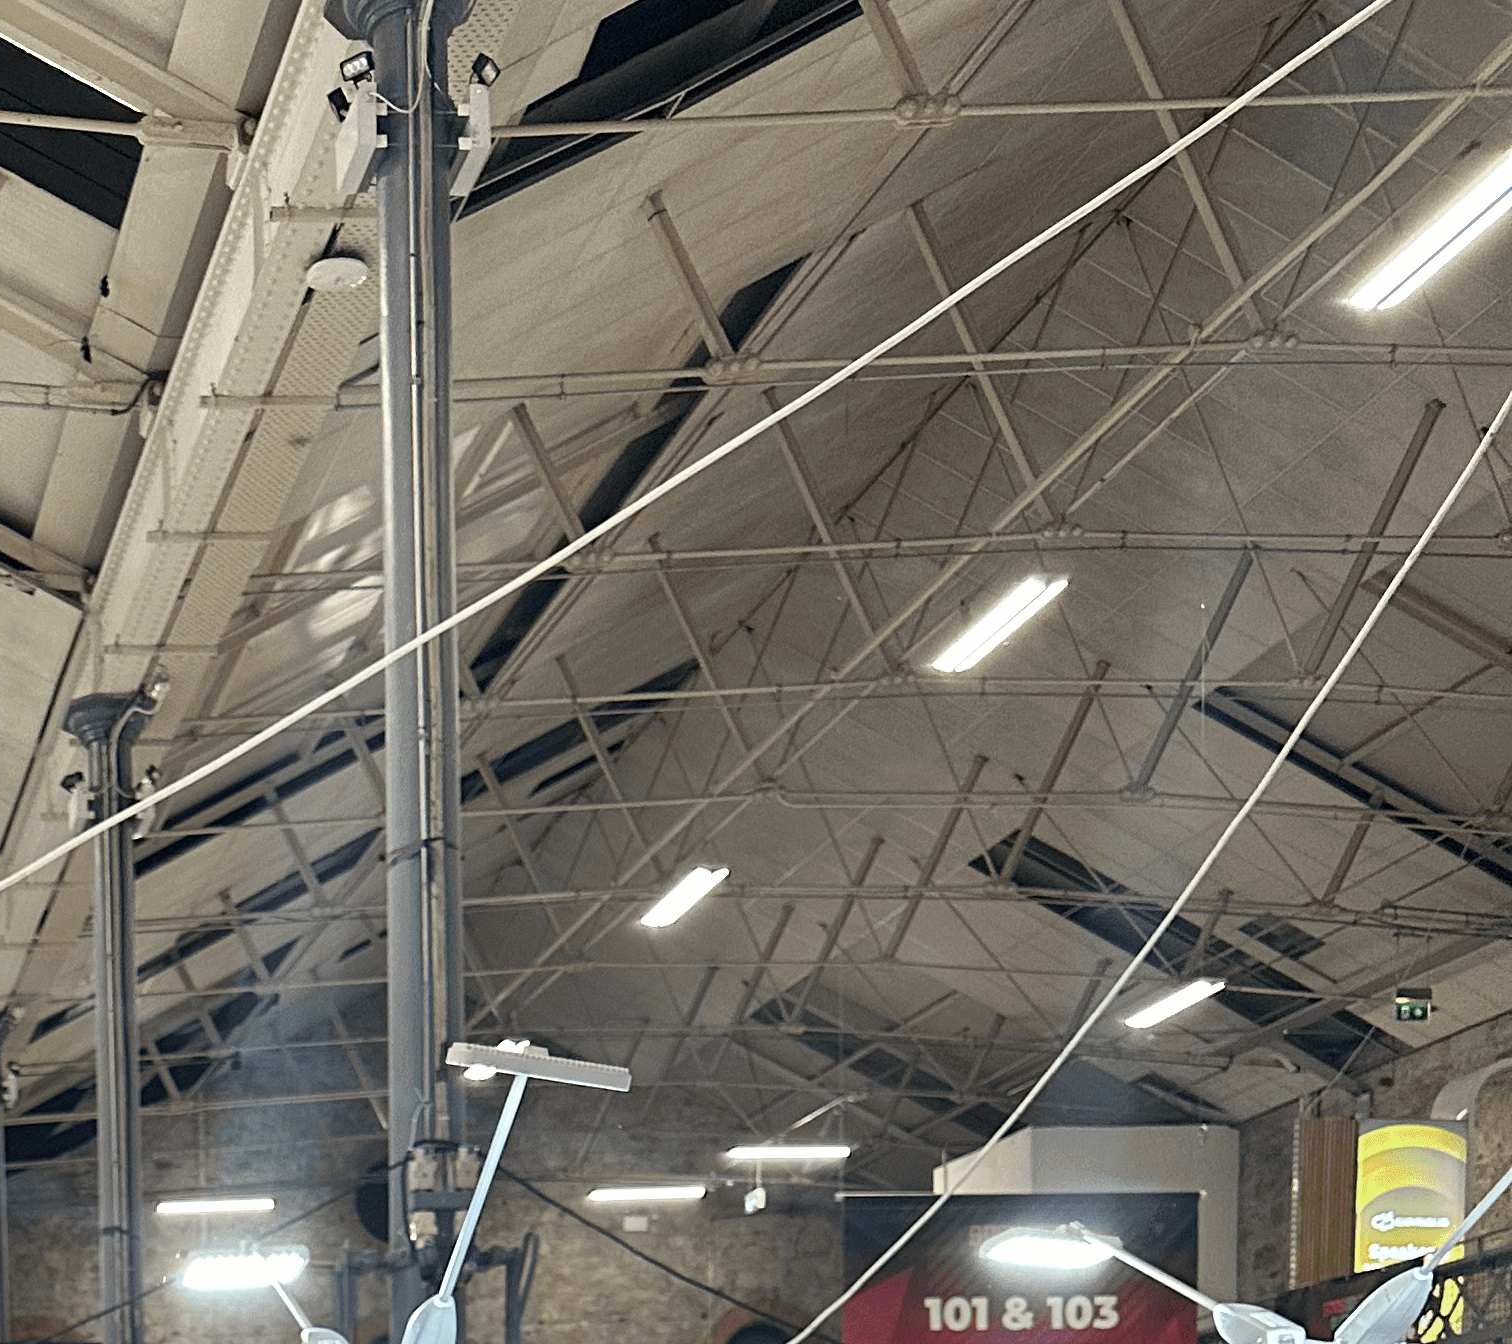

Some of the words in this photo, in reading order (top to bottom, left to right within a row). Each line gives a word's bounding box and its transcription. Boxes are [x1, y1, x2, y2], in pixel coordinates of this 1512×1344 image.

[925, 1295, 988, 1332] 101
[1001, 1296, 1035, 1331] &
[1046, 1295, 1121, 1330] 103
